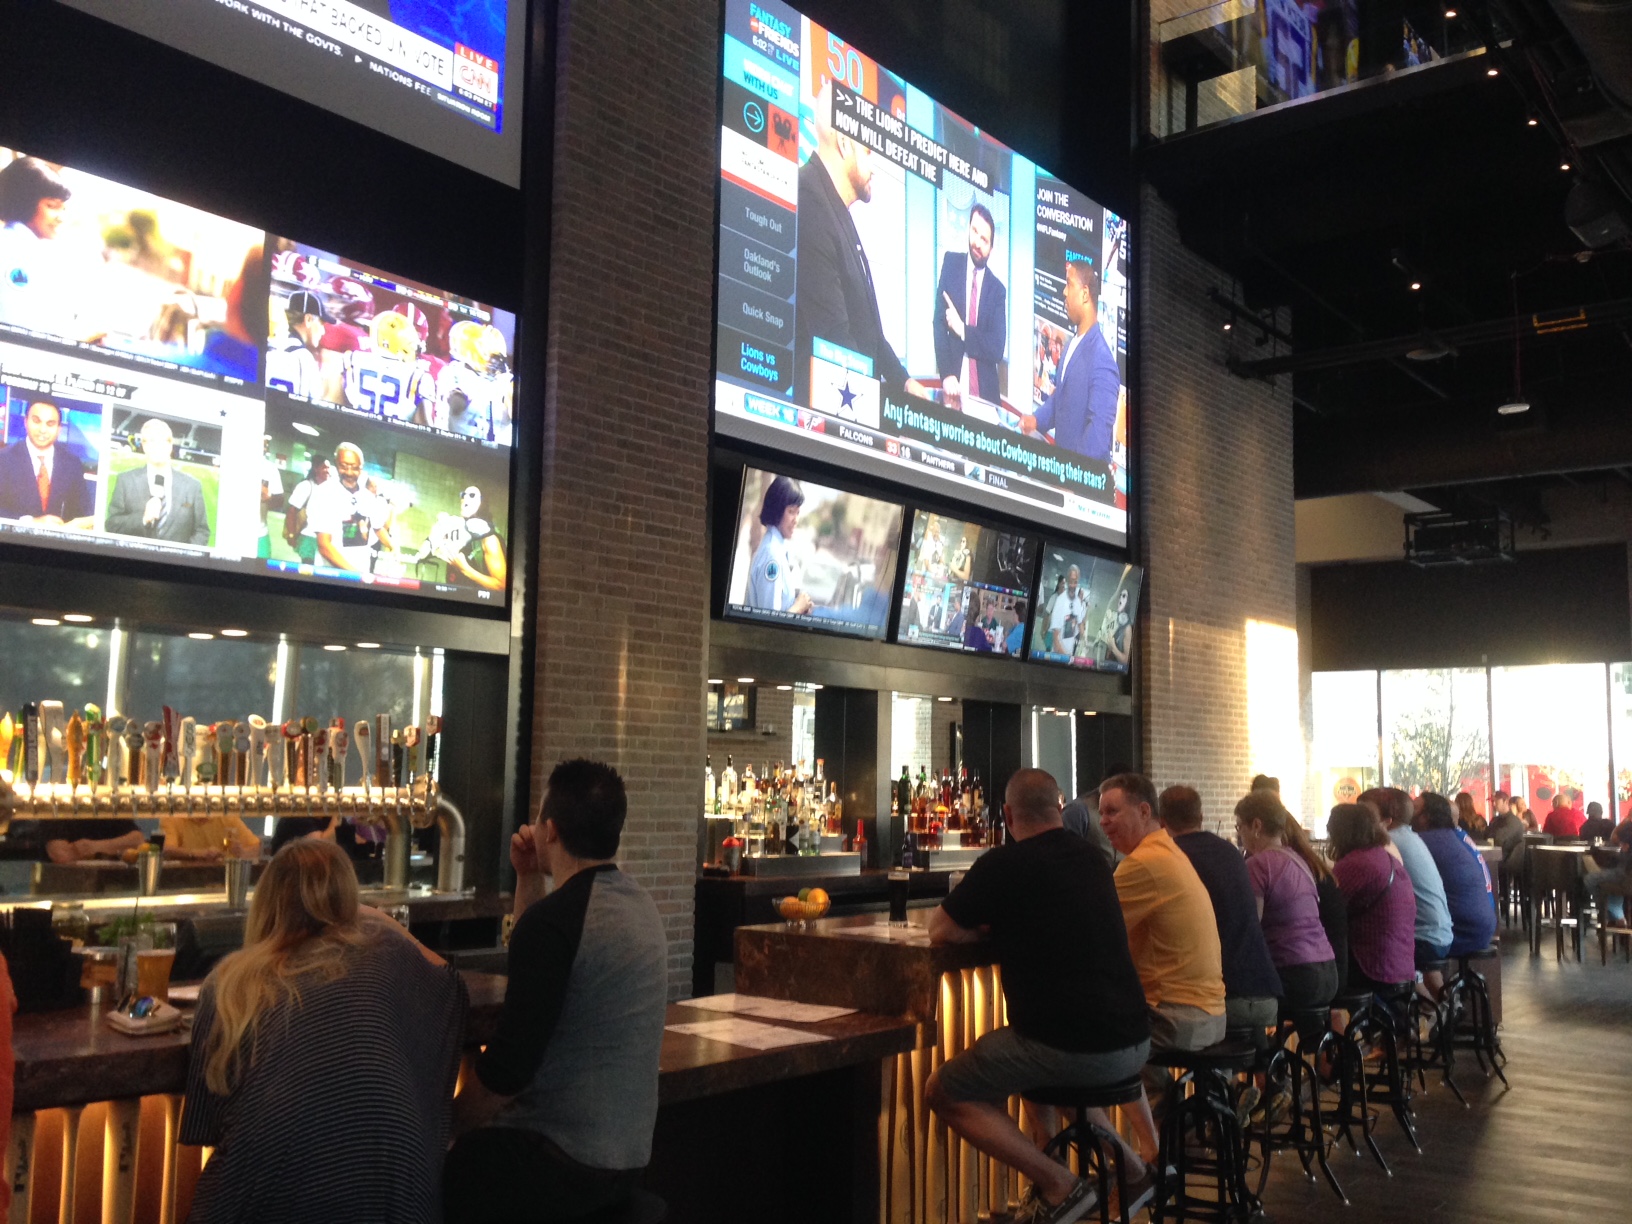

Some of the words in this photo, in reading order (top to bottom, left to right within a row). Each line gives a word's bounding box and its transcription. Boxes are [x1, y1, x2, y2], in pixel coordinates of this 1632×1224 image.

[215, 0, 249, 14] WORK
[251, 8, 281, 29] WITH
[282, 21, 304, 39] THE
[305, 32, 344, 57] GOVTS.
[750, 2, 791, 39] FANTASY
[758, 21, 799, 57] FRIENDS
[415, 49, 444, 76] VOTE
[460, 46, 494, 69] LIVE
[775, 49, 799, 71] LIVE
[827, 31, 864, 96] 50
[369, 61, 413, 88] NATIONS
[459, 65, 492, 94] CNN
[743, 71, 766, 93] WITH
[767, 82, 778, 100] US
[835, 109, 859, 137] NOW
[860, 123, 884, 152] WILL
[885, 136, 919, 172] DEFEAT
[919, 159, 937, 183] THE
[855, 95, 874, 122] THE
[876, 108, 903, 139] LIONS
[904, 124, 909, 142] I
[910, 128, 948, 165] PREDICT
[949, 153, 970, 179] HERE
[971, 167, 989, 189] AND
[1037, 188, 1053, 203] JOIN
[1054, 192, 1069, 207] THE
[745, 206, 768, 227] Tough
[769, 218, 782, 234] Out
[1036, 204, 1094, 233] CONVERSATION
[743, 261, 772, 283] Outlook
[744, 248, 780, 273] Oakland's
[742, 302, 764, 320] Quick
[765, 311, 784, 329] Snap
[741, 342, 764, 362] Lions
[765, 352, 776, 366] vs
[740, 357, 779, 382] Cowboys
[359, 368, 401, 419] 52
[747, 397, 780, 418] WEEK
[839, 426, 874, 446] FALCONS
[988, 473, 1009, 488] FINAL
[883, 397, 903, 429] Any
[904, 404, 940, 442] fantasy
[941, 422, 975, 447] worries
[975, 431, 1000, 455] about
[1001, 438, 1037, 472] Cowboys
[1037, 455, 1066, 483] resting
[1065, 461, 1083, 484] their
[1083, 470, 1107, 491] stars?
